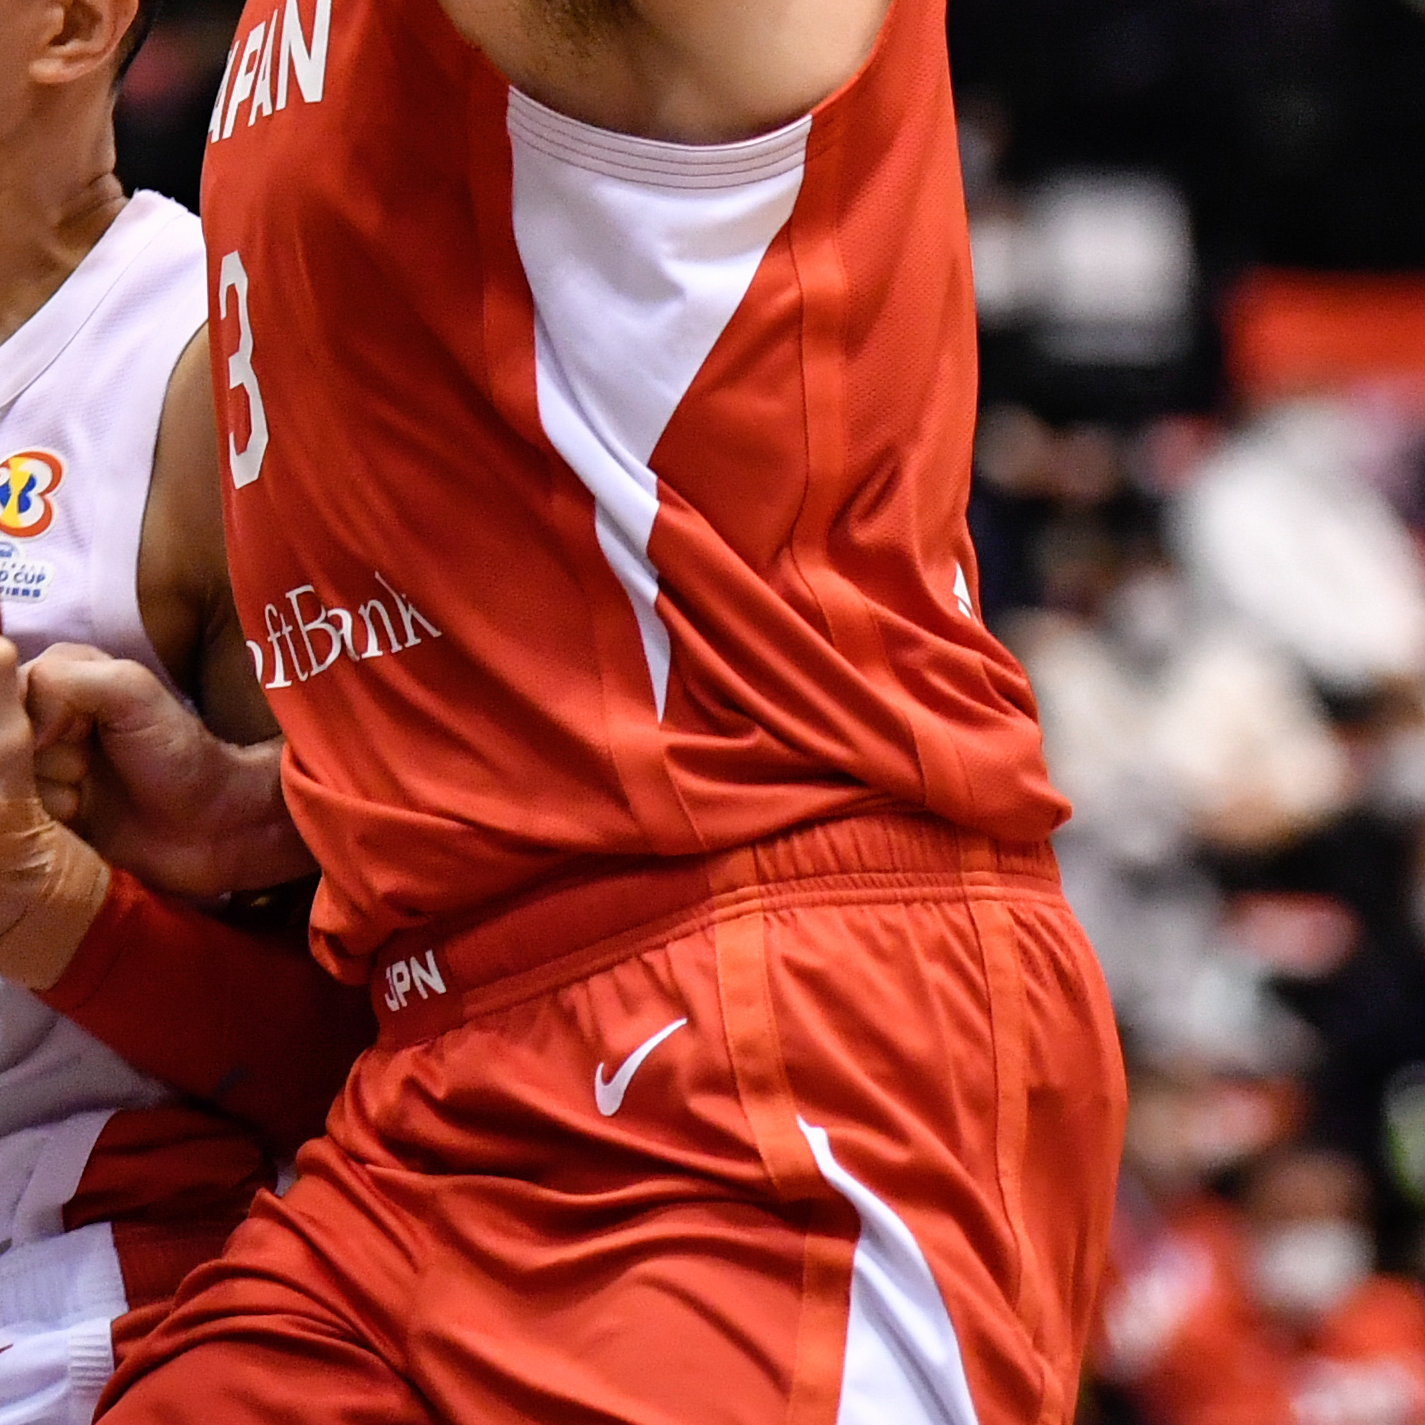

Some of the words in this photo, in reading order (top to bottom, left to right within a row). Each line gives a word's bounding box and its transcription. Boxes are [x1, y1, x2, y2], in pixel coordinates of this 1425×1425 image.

[218, 250, 269, 489] 3
[246, 571, 442, 689] oftBank
[385, 948, 447, 1012] JPN
